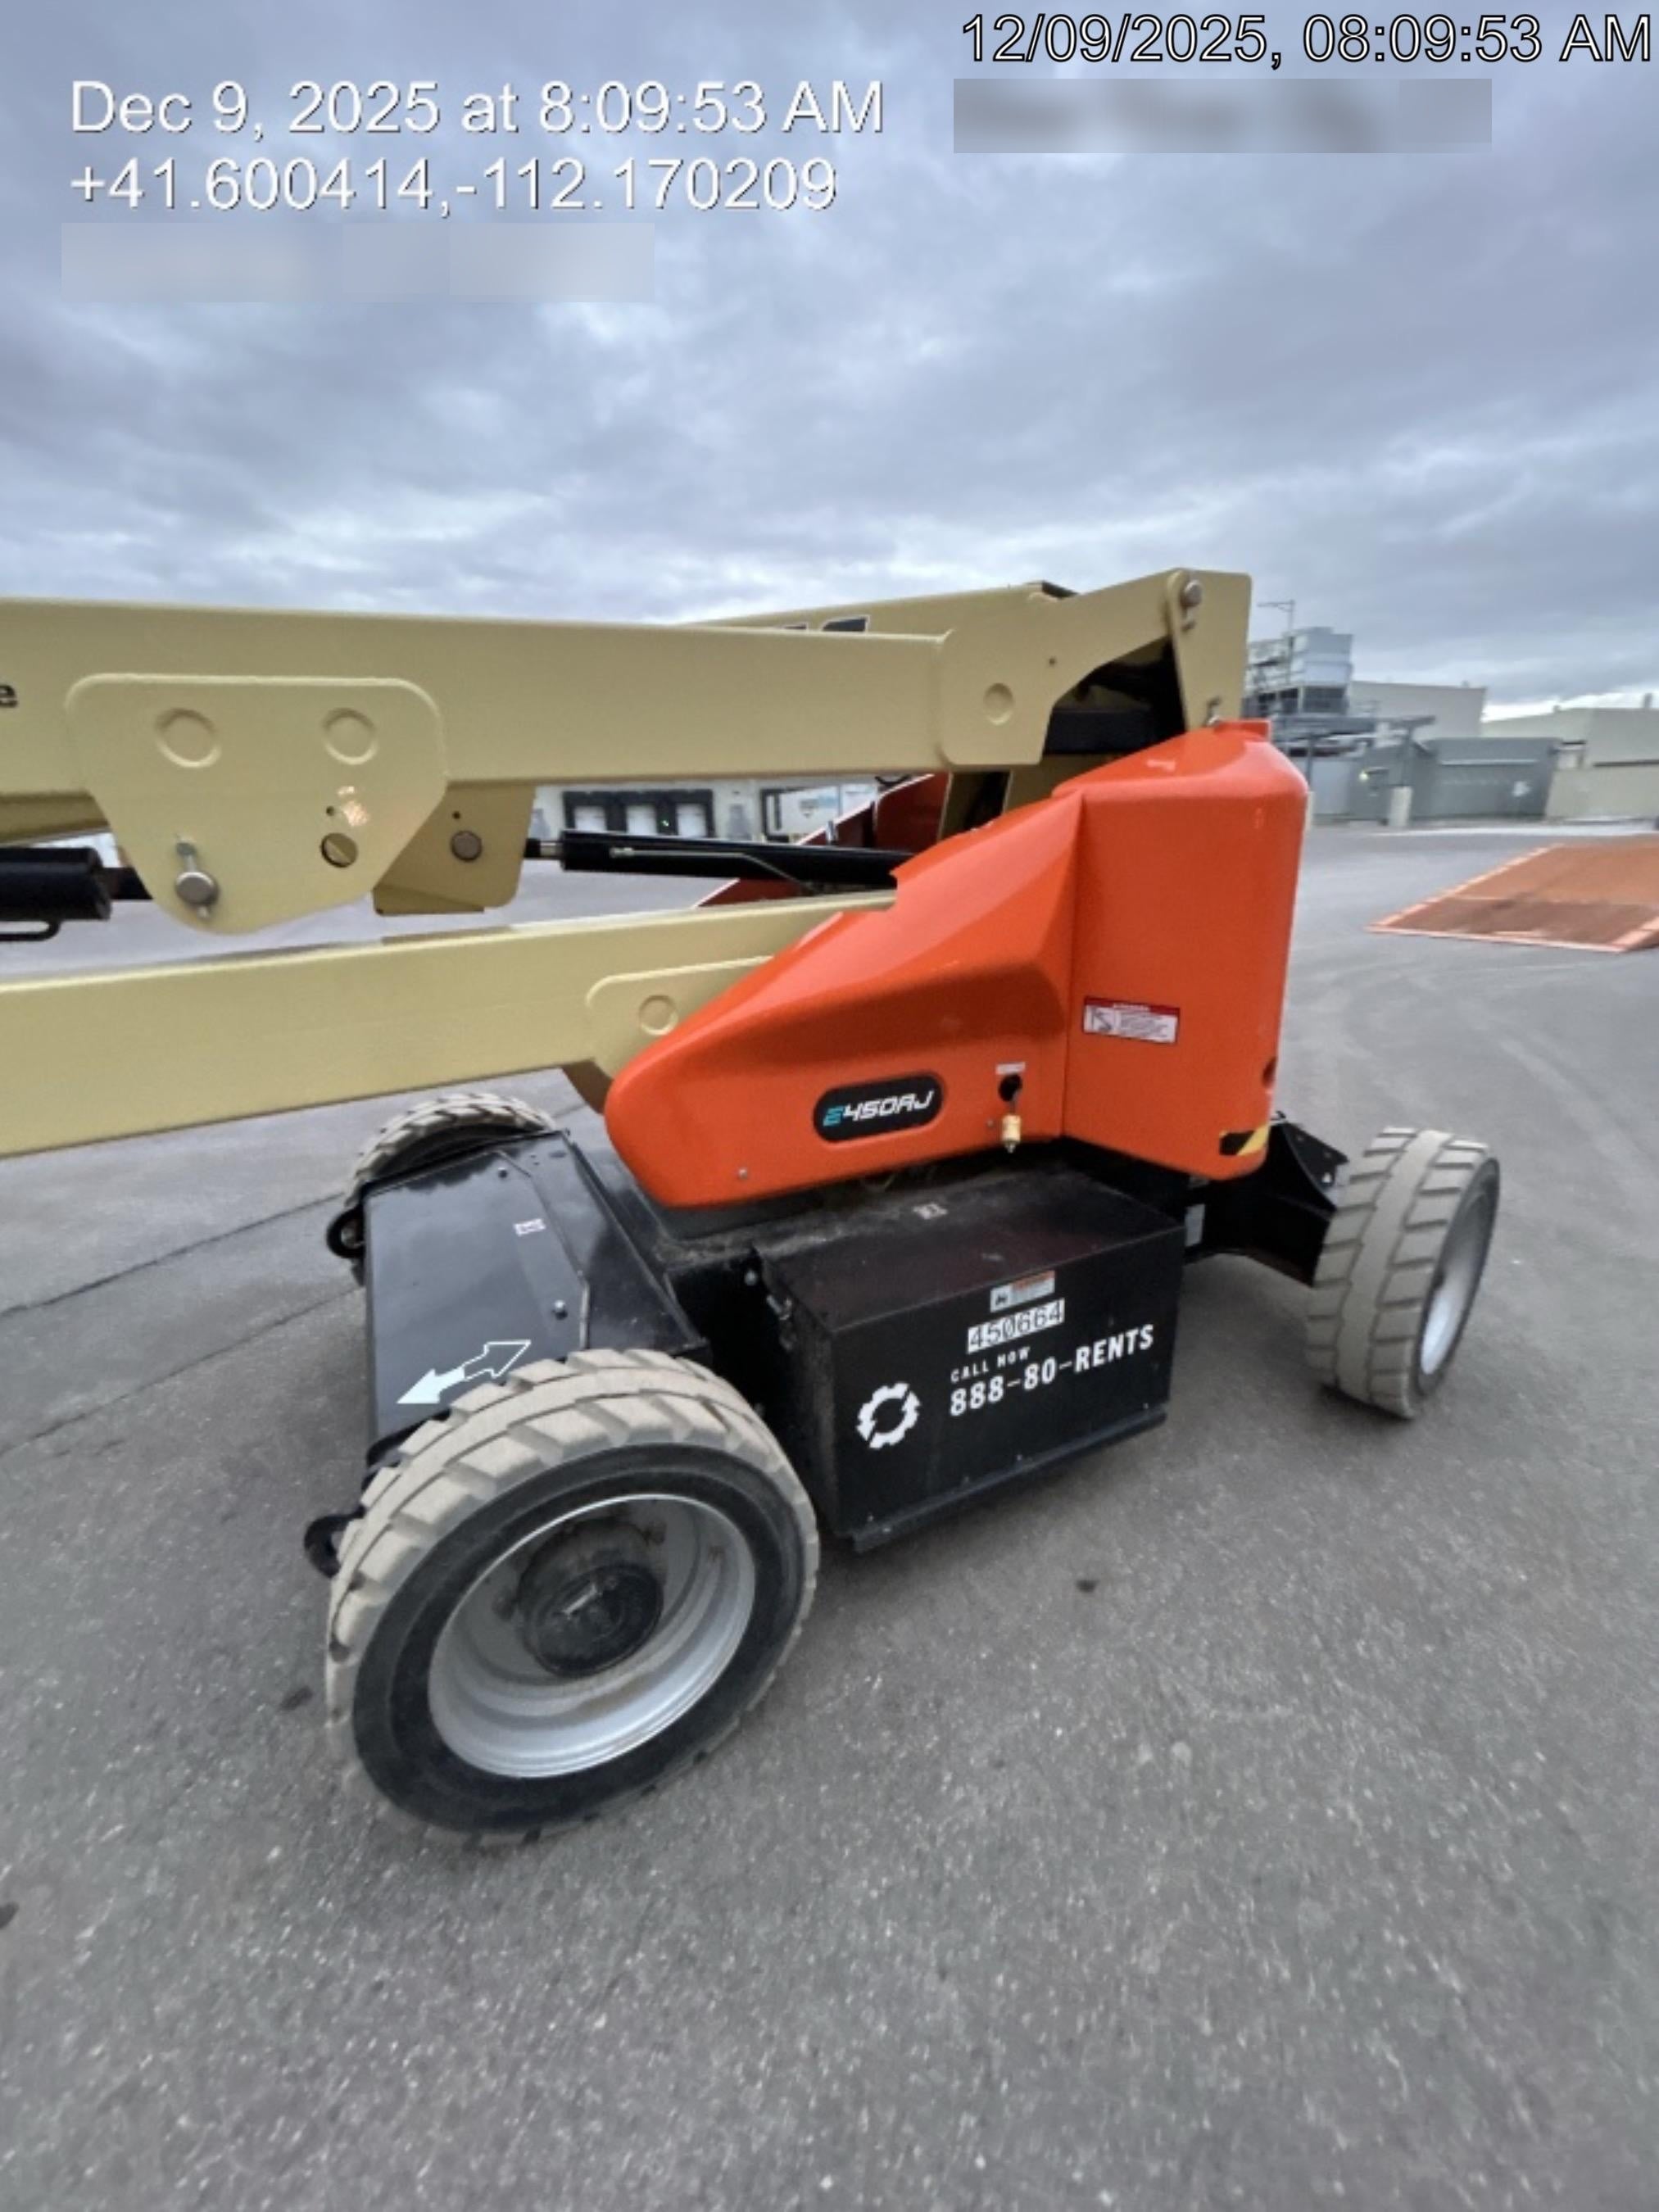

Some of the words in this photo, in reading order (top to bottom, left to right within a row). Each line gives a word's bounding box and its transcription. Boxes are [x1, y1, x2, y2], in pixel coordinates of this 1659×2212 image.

[823, 1090, 934, 1126] E450AJ
[970, 1301, 1062, 1348] 450664
[950, 1360, 989, 1383] CALL
[997, 1346, 1031, 1368] NOW
[950, 1325, 1154, 1416] 888-80-RENTS
